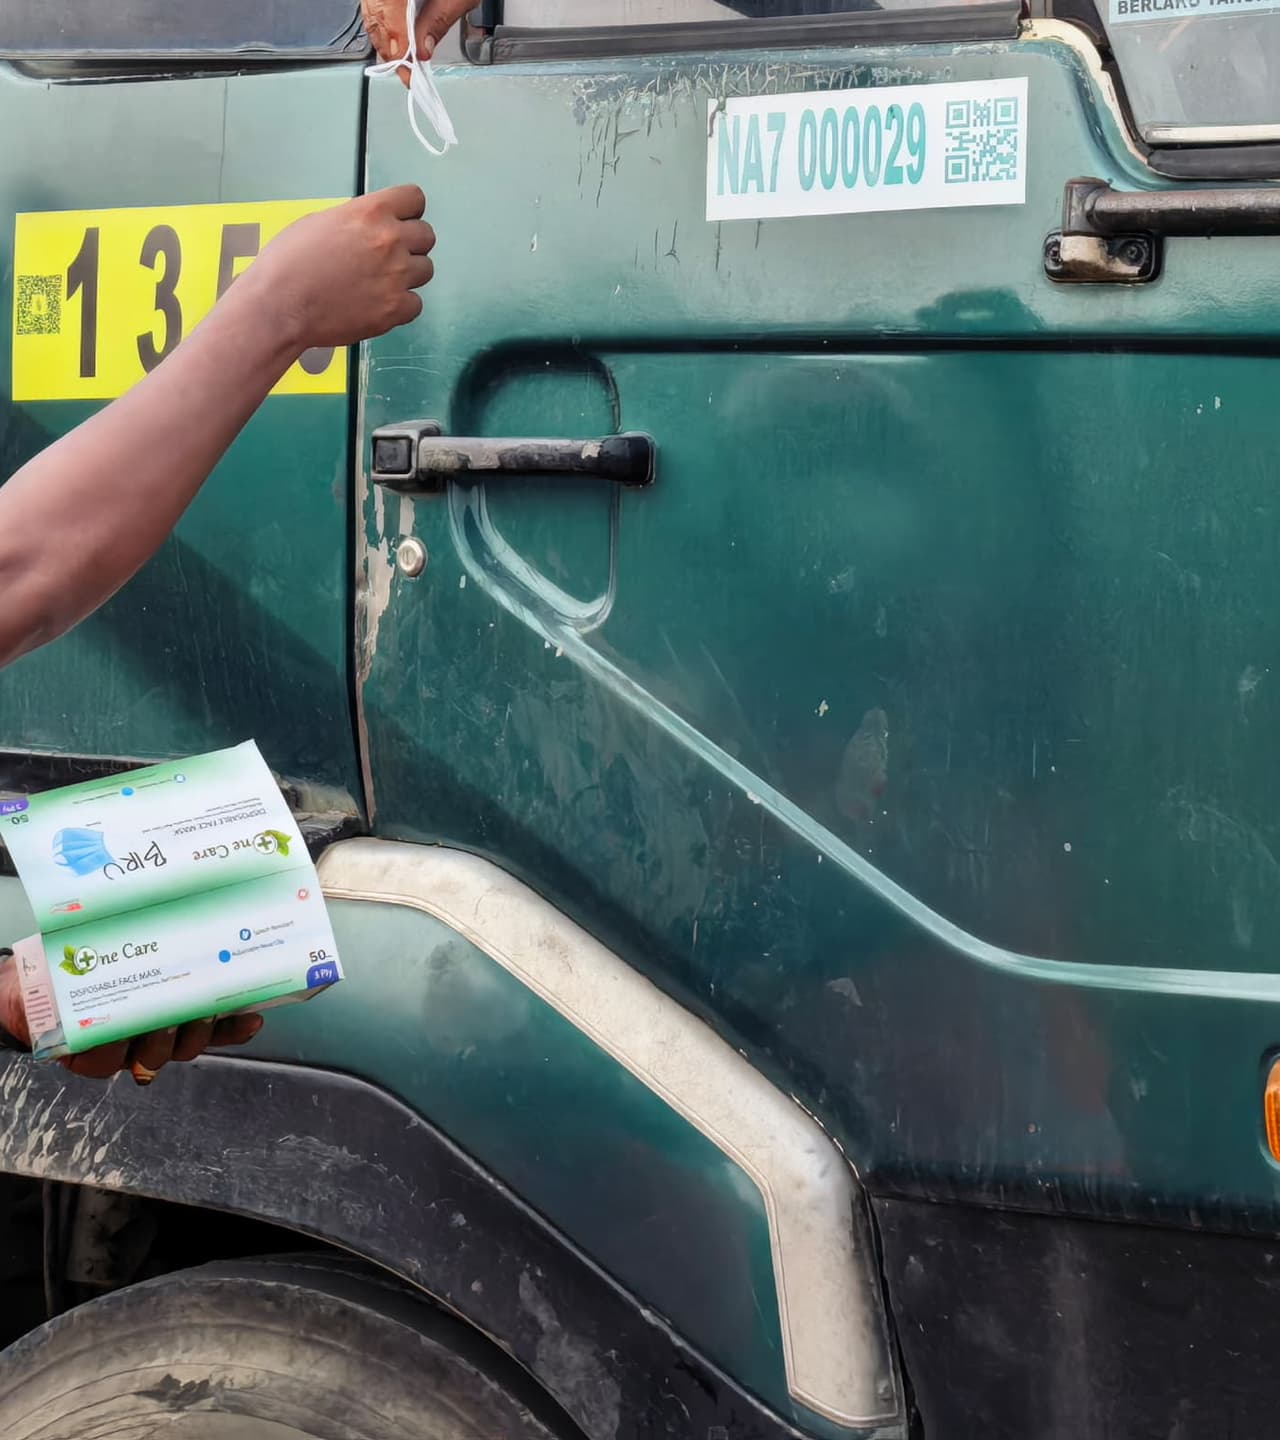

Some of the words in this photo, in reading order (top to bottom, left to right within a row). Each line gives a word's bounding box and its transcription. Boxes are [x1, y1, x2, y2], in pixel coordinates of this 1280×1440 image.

[717, 111, 786, 195] NA7
[798, 102, 926, 192] 000029
[103, 841, 167, 880] BIRU
[122, 939, 159, 960] Care
